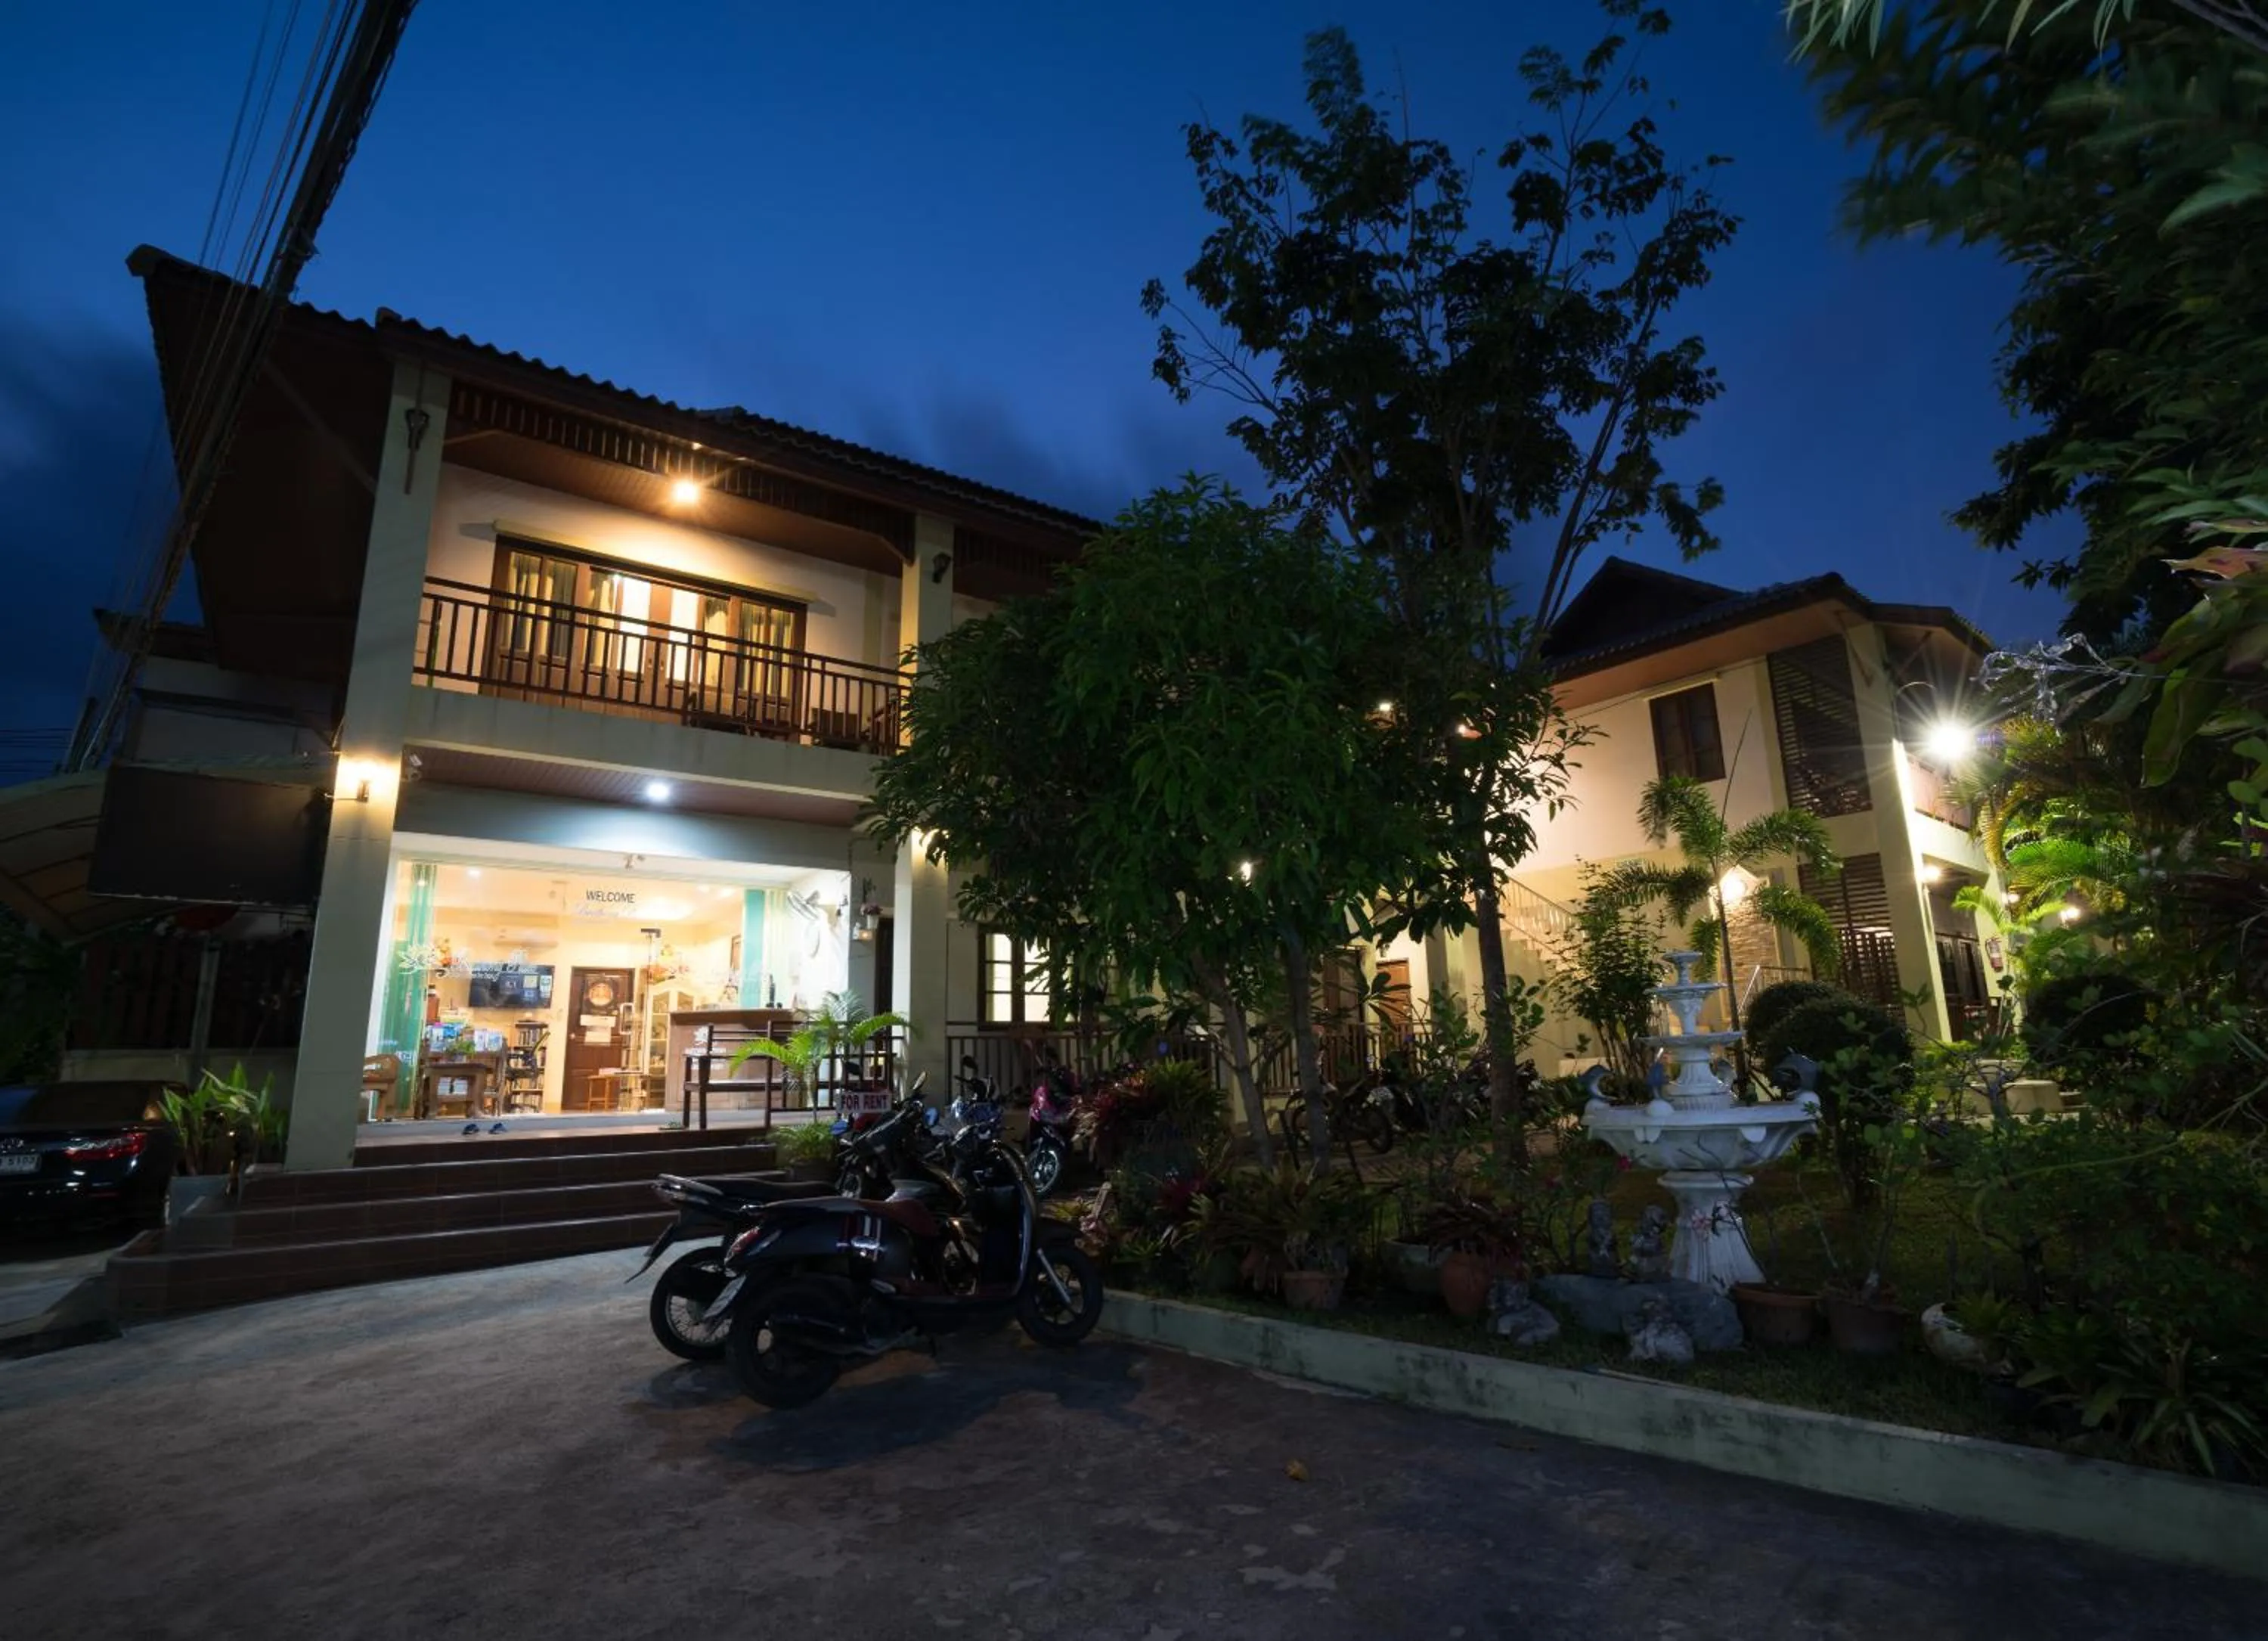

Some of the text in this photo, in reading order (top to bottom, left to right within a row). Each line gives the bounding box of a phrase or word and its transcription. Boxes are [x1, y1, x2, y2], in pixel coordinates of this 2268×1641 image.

[586, 890, 636, 903] WELCOME
[841, 1094, 888, 1110] FOR RENT
